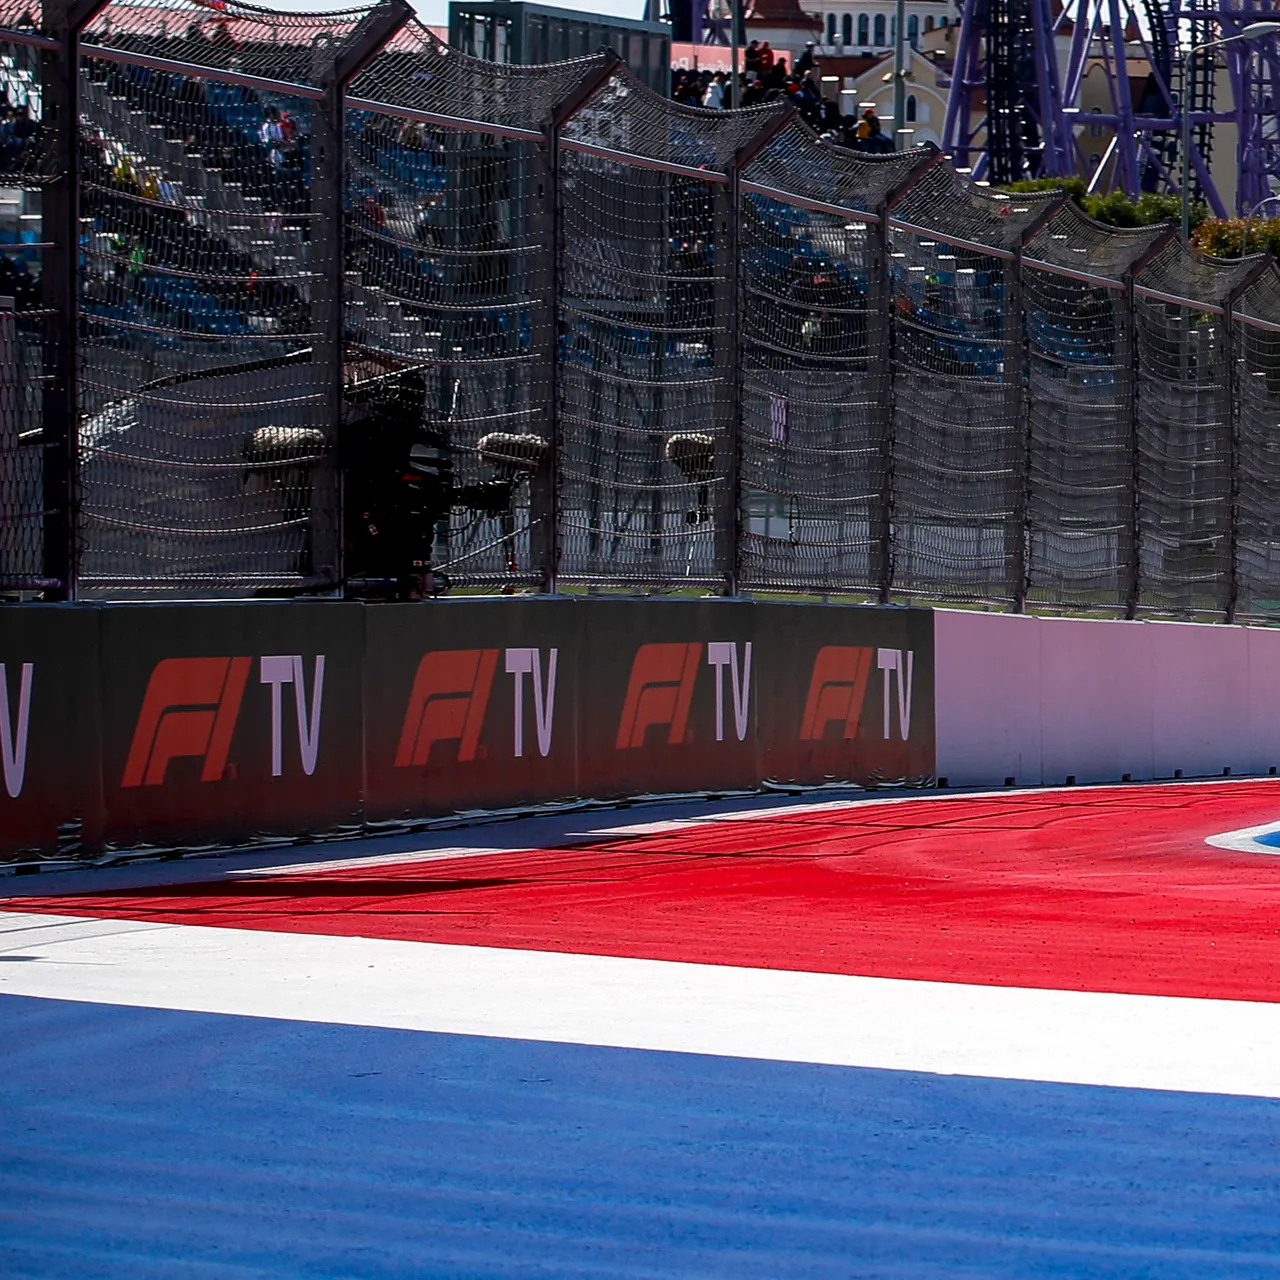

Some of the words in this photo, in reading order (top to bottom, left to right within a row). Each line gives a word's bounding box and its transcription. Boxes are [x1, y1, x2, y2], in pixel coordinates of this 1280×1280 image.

[0, 663, 33, 797] V
[261, 655, 325, 776] TV
[506, 648, 557, 757] TV
[708, 642, 751, 741] TV
[878, 648, 913, 740] TV
